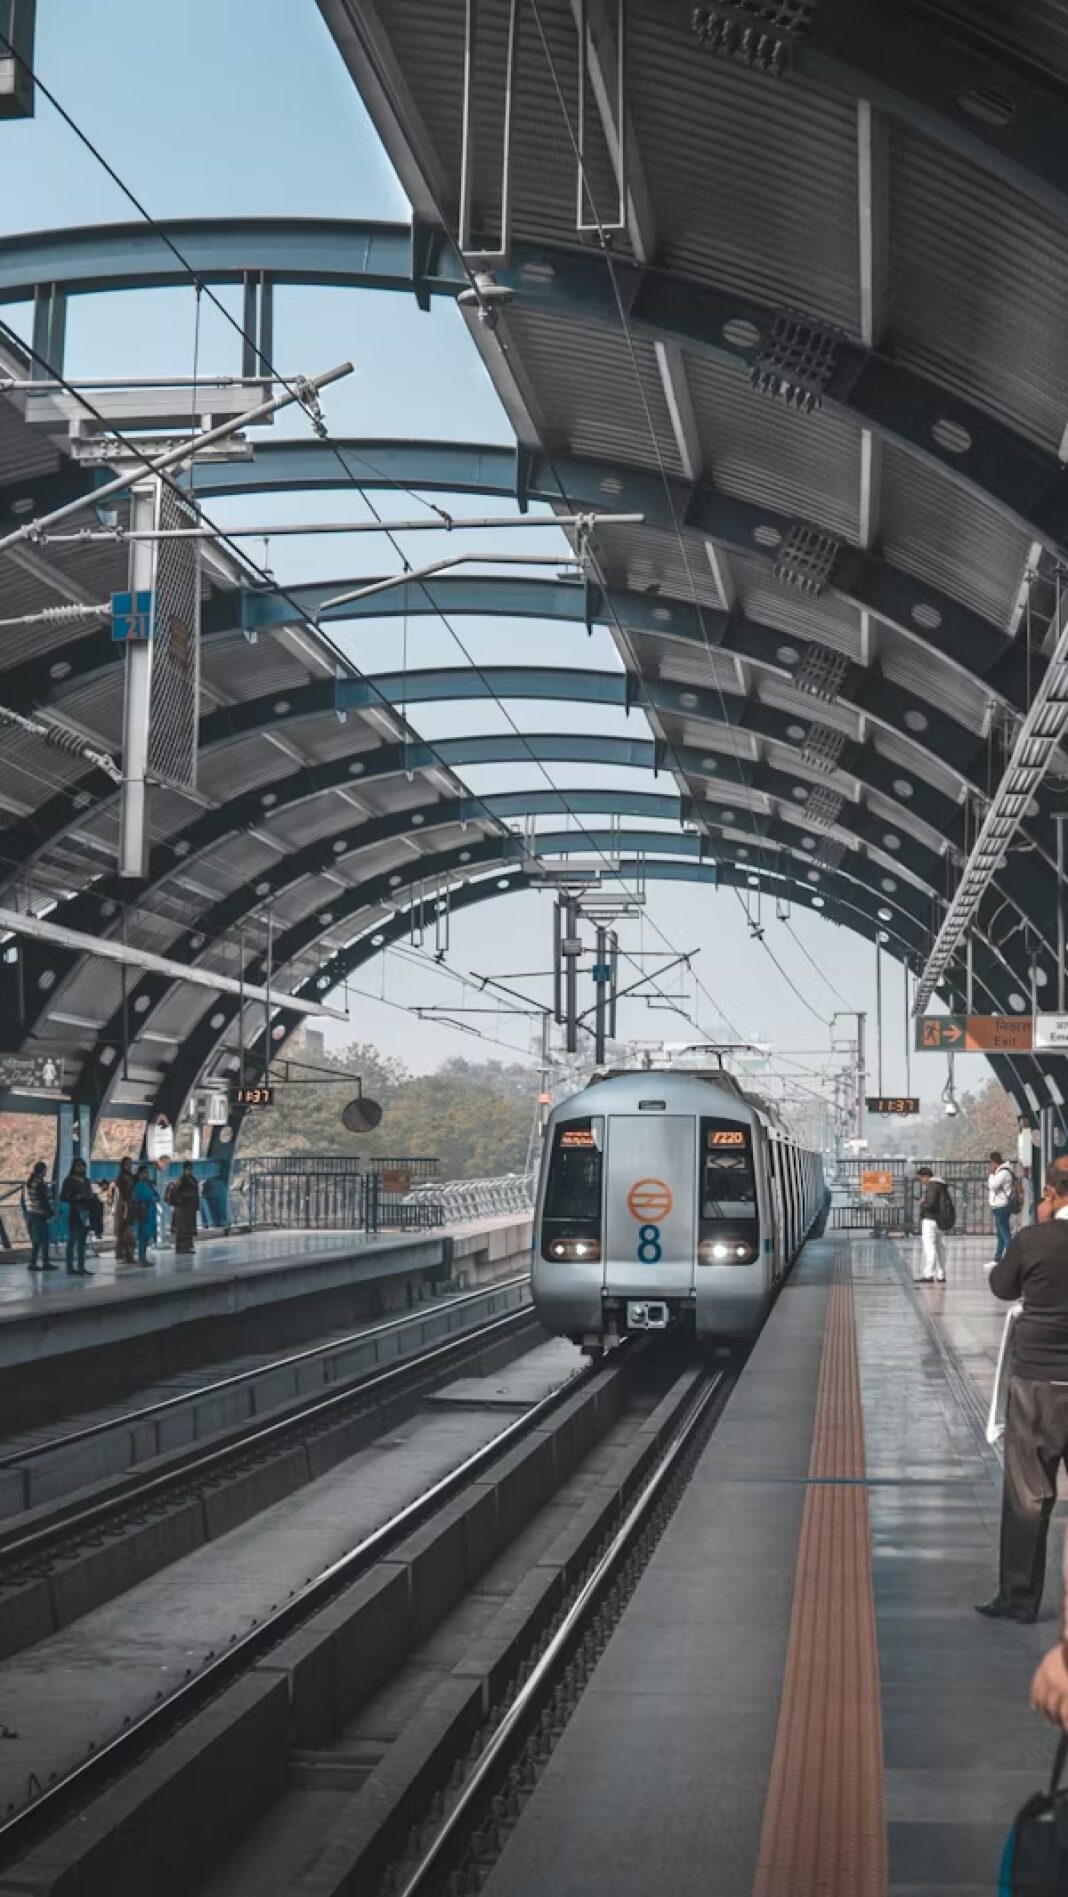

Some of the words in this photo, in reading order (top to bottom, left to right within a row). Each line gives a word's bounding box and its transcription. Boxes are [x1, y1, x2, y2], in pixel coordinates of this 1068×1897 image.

[994, 1035, 1016, 1047] Exit
[237, 1089, 270, 1103] 11:37
[878, 1100, 914, 1112] 11:37
[638, 1224, 662, 1264] 8
